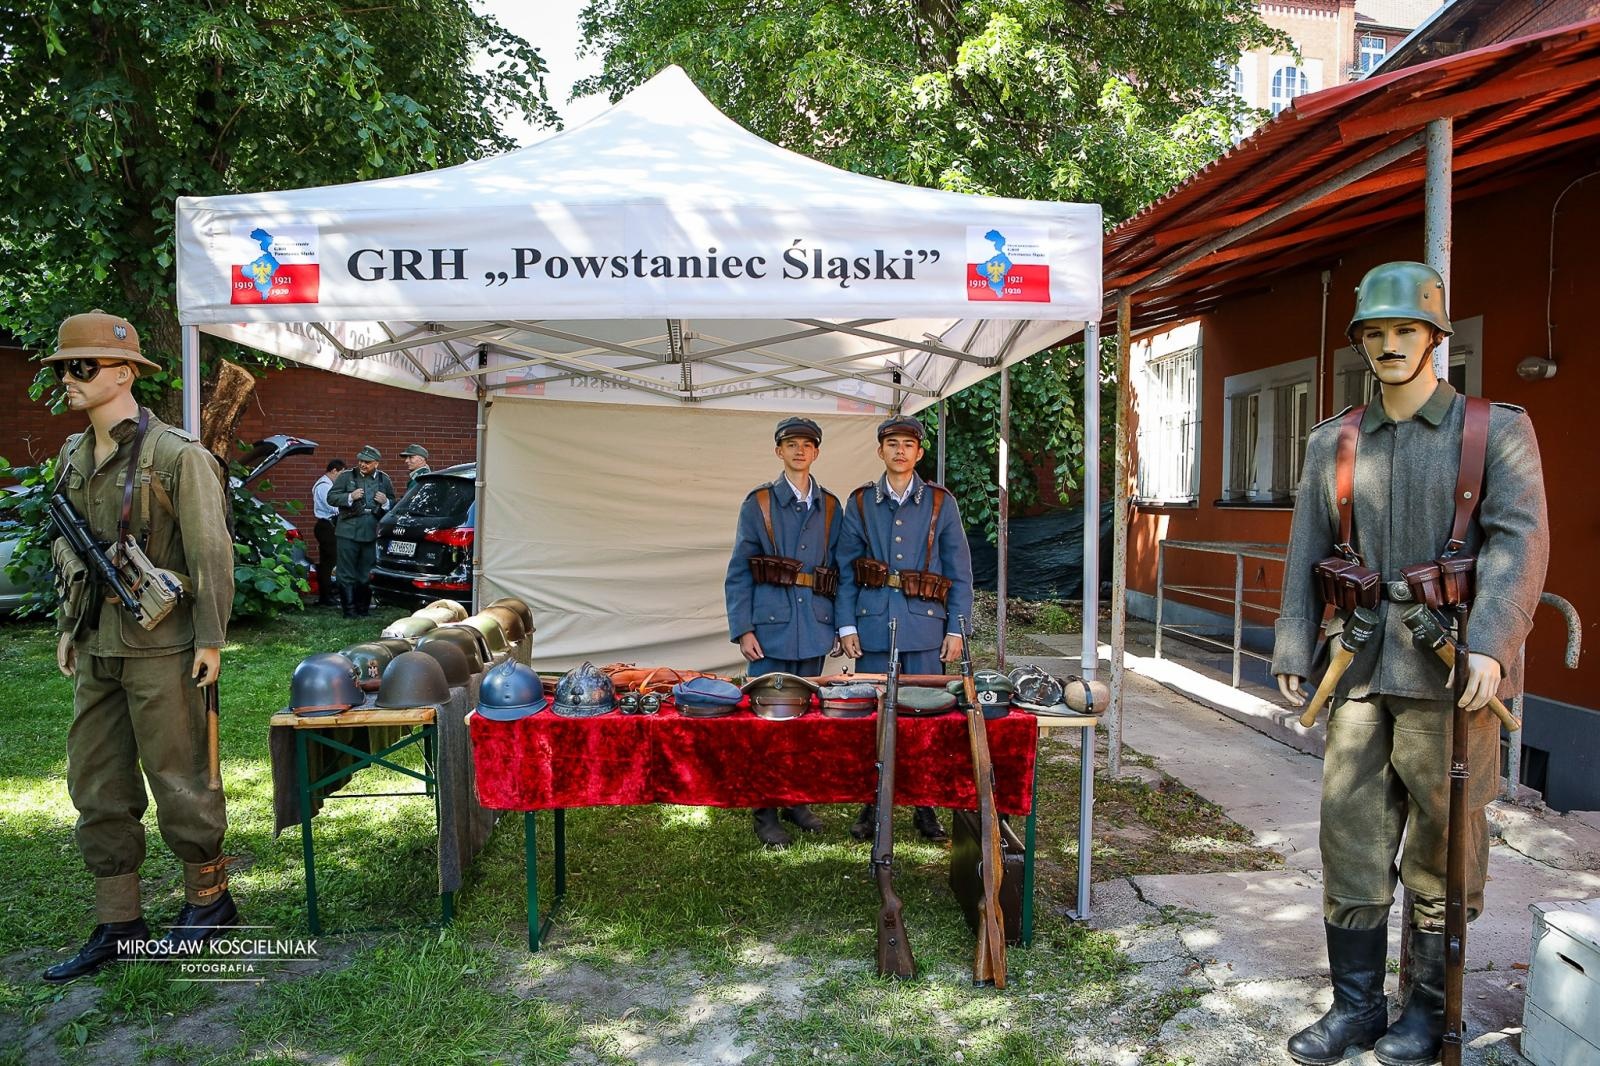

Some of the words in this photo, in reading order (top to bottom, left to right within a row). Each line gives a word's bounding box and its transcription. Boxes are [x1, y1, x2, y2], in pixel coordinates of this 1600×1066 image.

[347, 248, 469, 282] GRH
[484, 247, 767, 287] „Powstaniec
[782, 238, 940, 289] Śląski”
[274, 276, 292, 286] 1921
[969, 279, 988, 289] 1919
[1007, 276, 1024, 284] 1921
[234, 281, 254, 291] 1919
